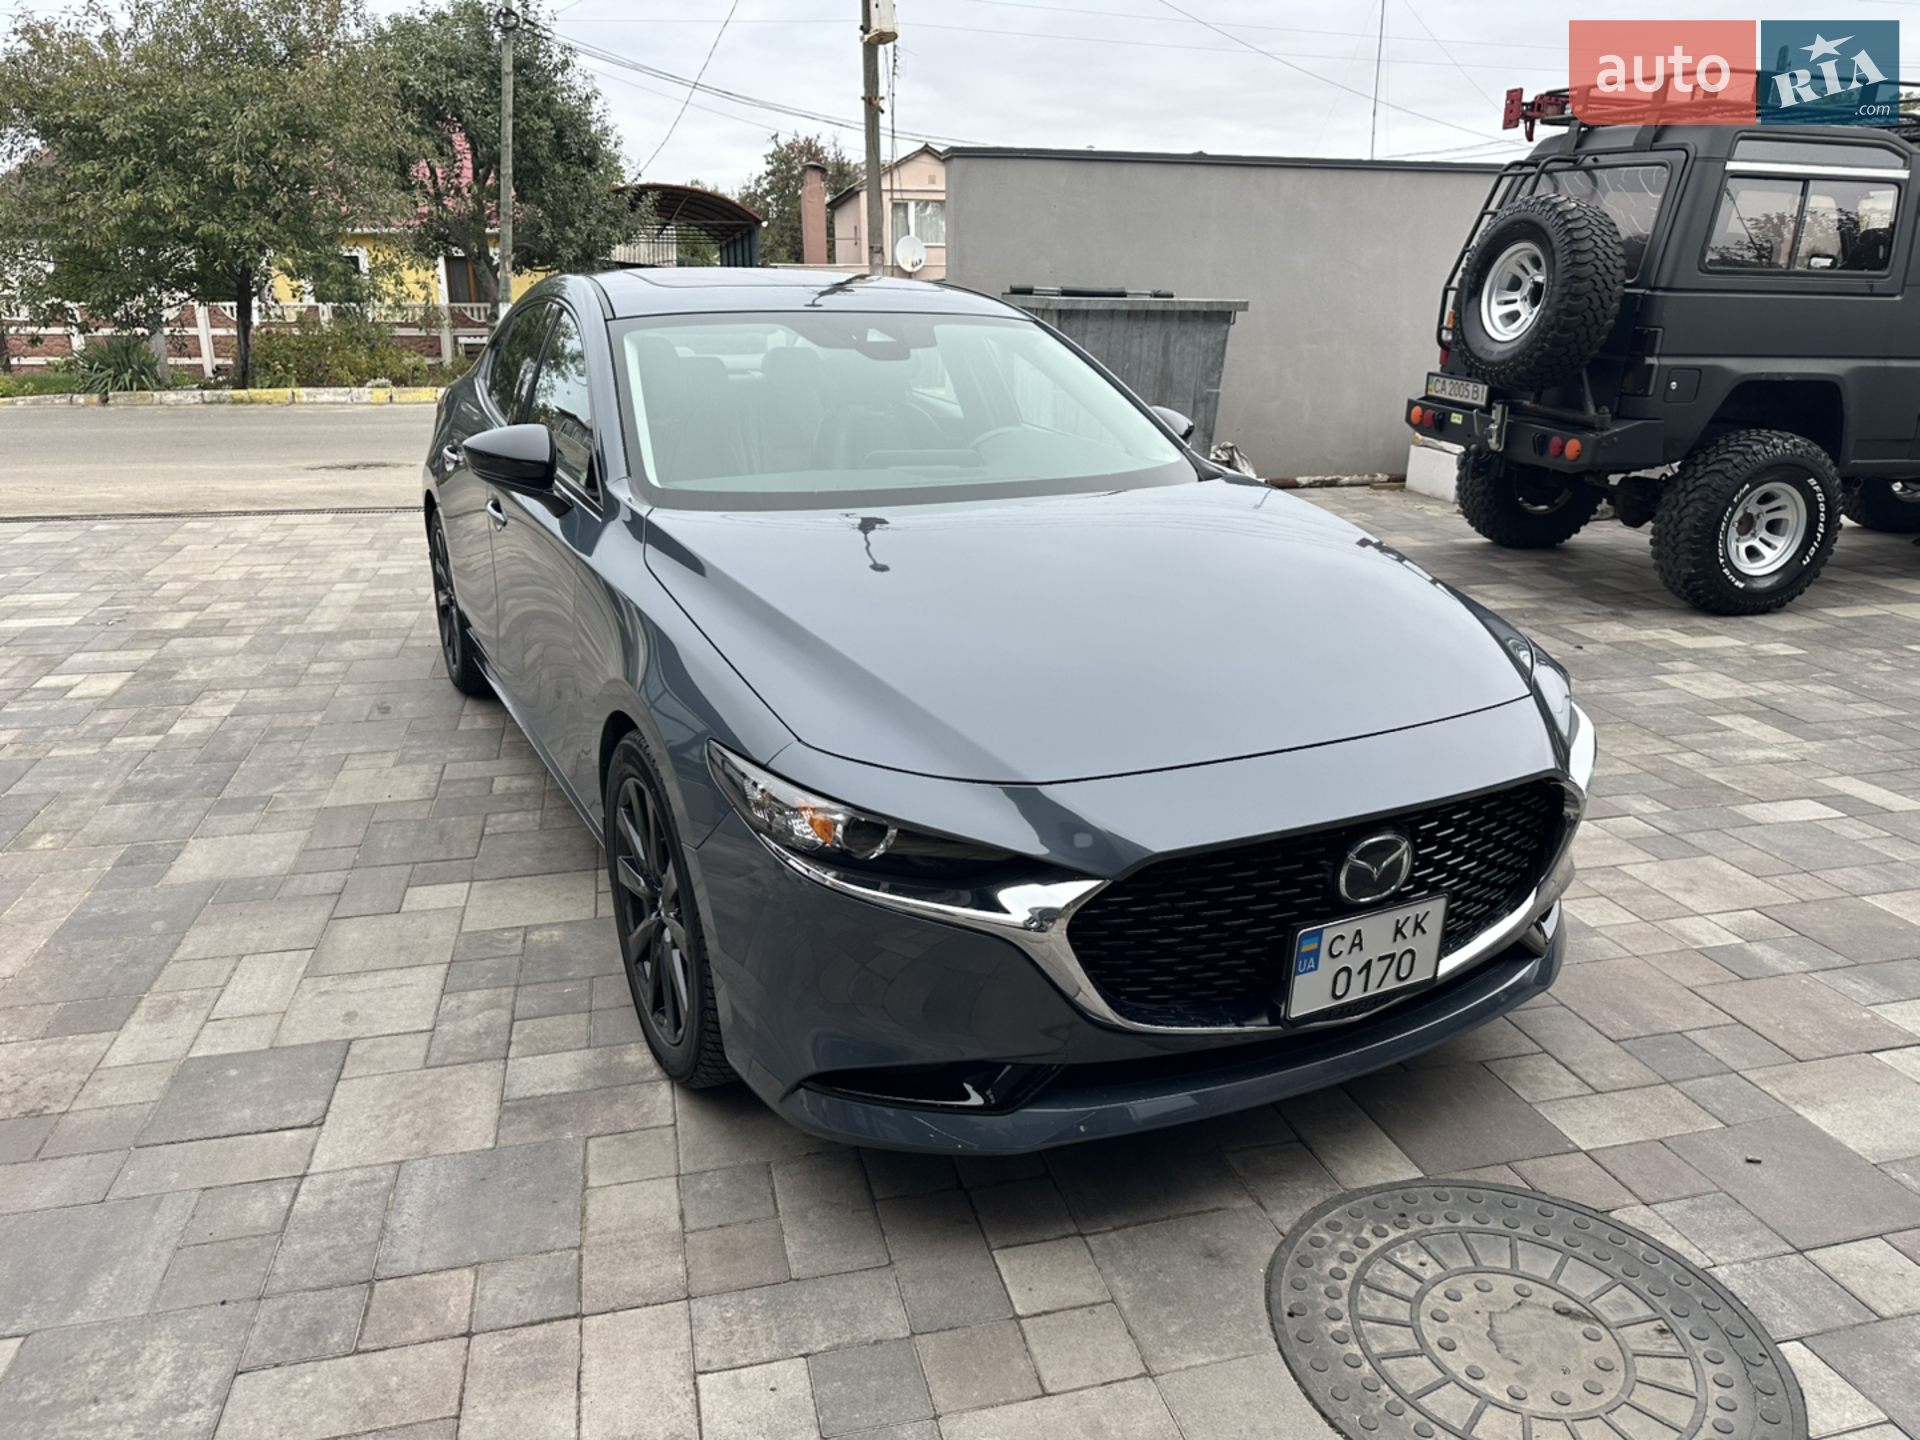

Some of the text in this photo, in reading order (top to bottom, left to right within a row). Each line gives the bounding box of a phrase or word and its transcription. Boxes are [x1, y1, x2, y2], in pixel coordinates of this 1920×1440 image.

[1434, 378, 1447, 396] CA
[1448, 380, 1471, 399] 2005
[1328, 910, 1431, 959] CA KK
[1298, 957, 1316, 973] UA
[1331, 947, 1417, 1000] 0170
